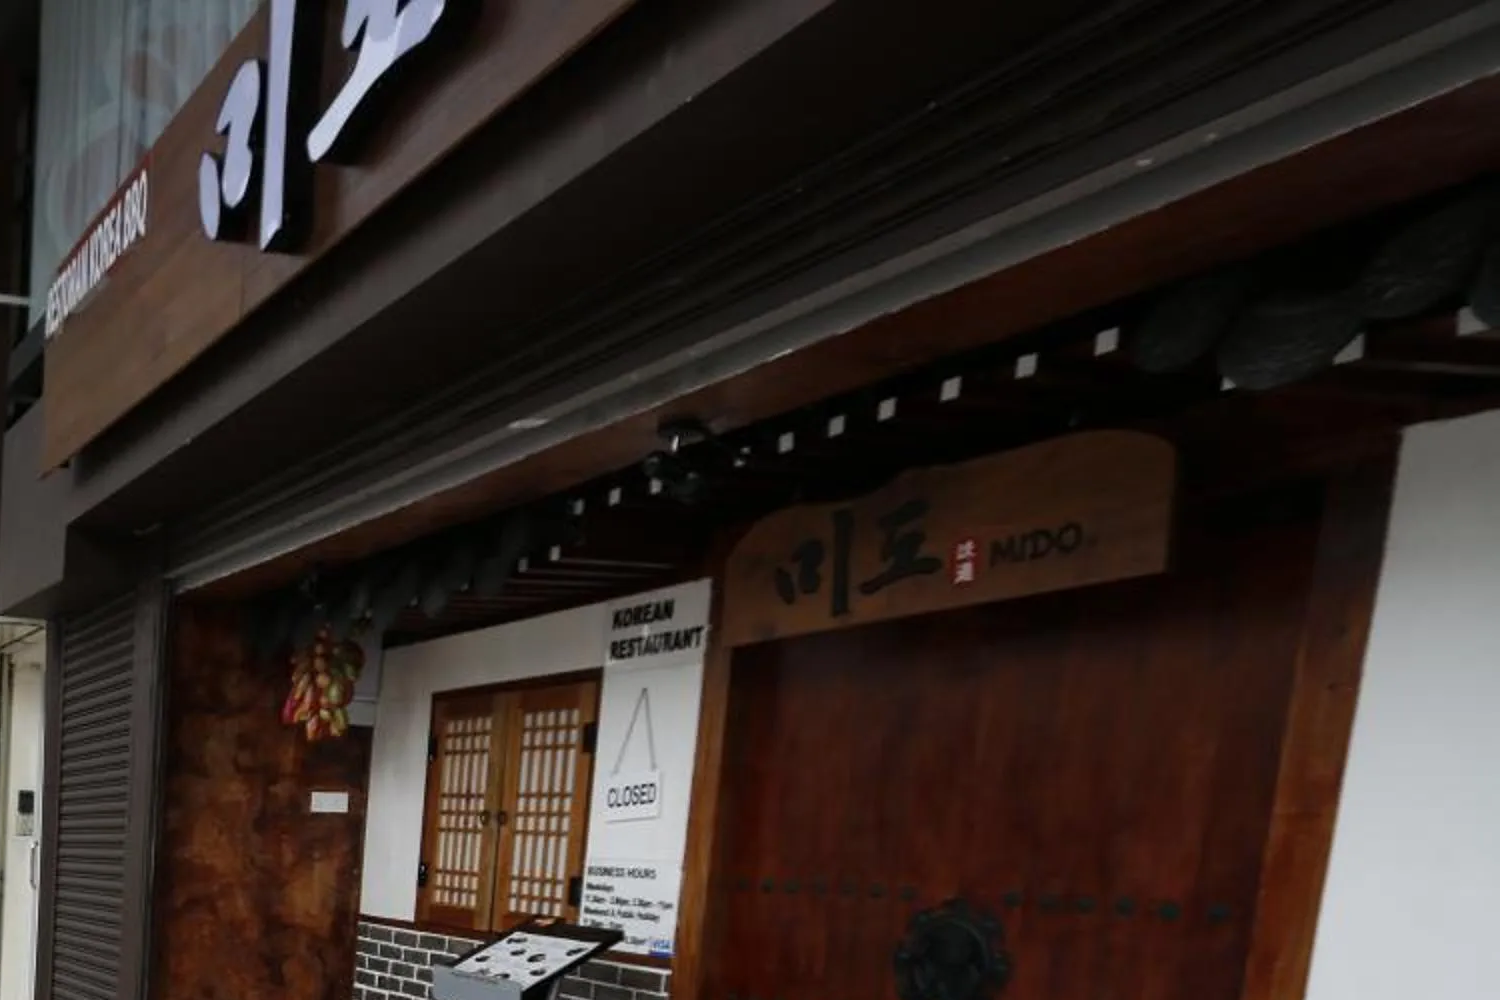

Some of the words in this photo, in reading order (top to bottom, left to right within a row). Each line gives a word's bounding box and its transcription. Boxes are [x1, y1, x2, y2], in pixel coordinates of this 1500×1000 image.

[44, 239, 89, 340] RESTORAN
[88, 200, 123, 290] KOREA
[122, 169, 148, 248] BBQ
[989, 522, 1083, 569] MIDO
[611, 597, 676, 630] KOREAN
[609, 624, 706, 661] RESTAURANT
[607, 782, 657, 809] CLOSED
[588, 866, 625, 878] BUSINESS
[627, 867, 657, 880] HOURS
